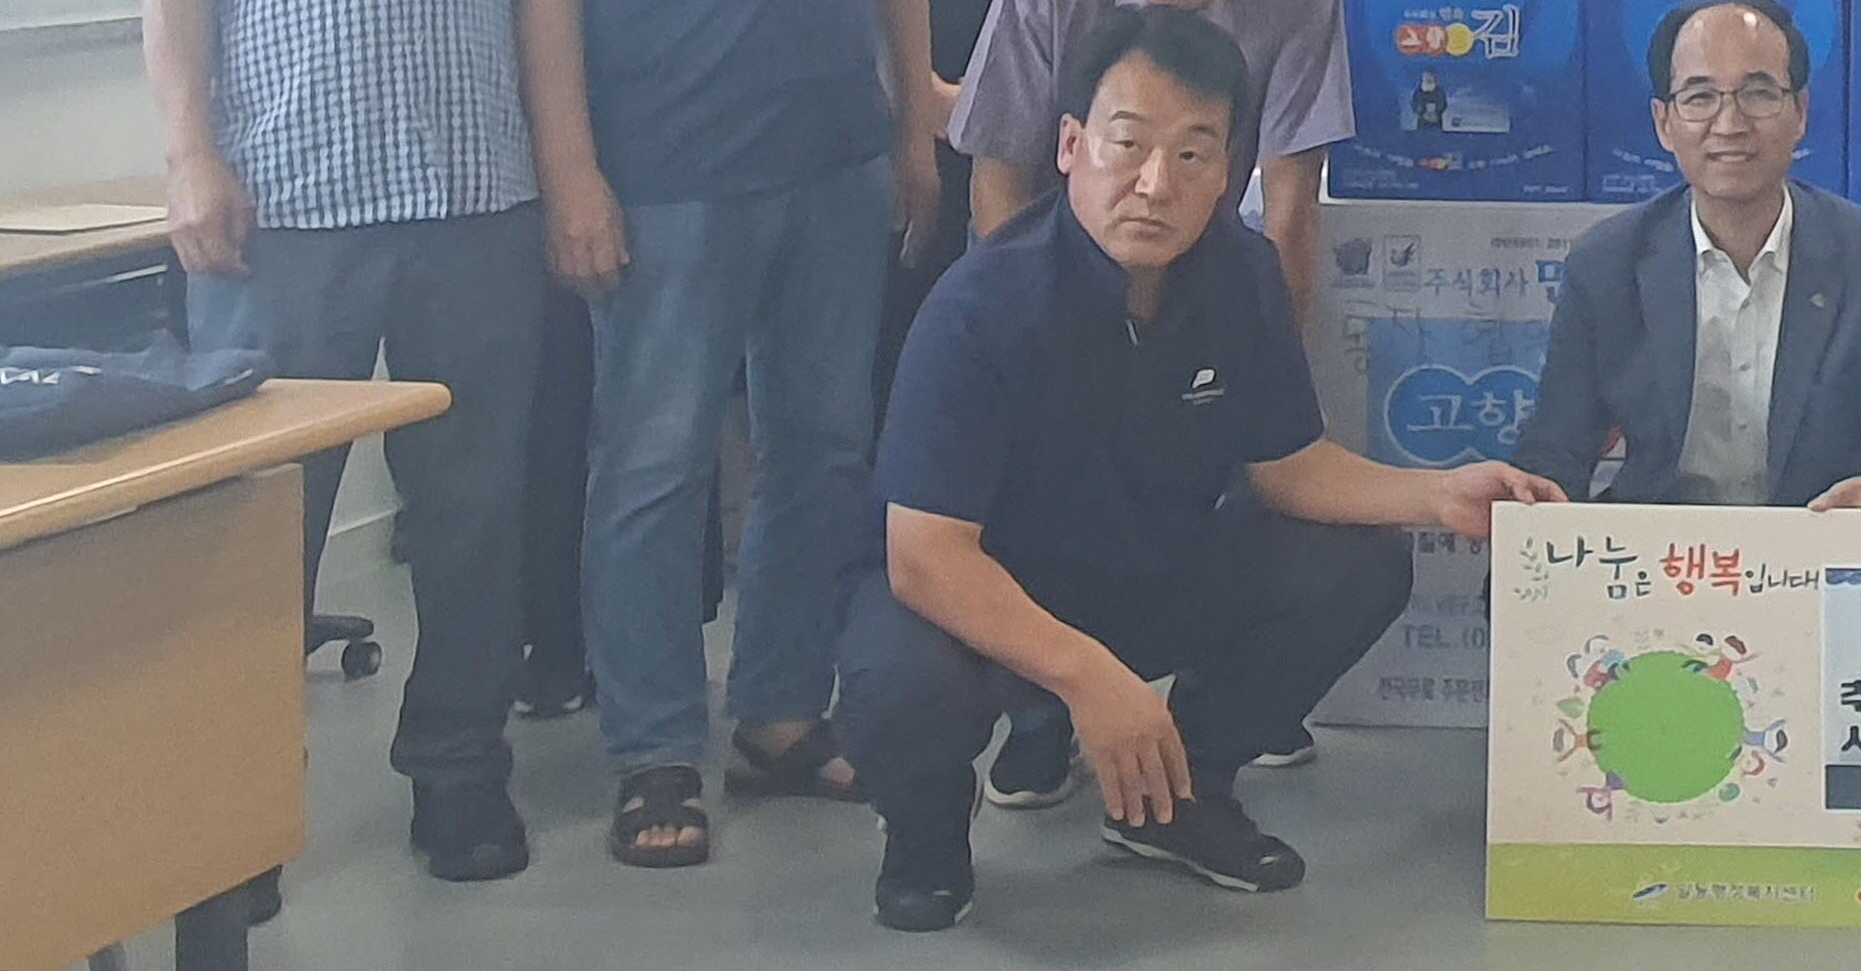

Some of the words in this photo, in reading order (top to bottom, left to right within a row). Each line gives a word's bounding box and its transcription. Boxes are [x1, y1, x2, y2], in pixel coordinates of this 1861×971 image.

[1424, 267, 1530, 297] 주식회사
[1406, 389, 1536, 445] 고향
[1546, 535, 1651, 600] 나눔은
